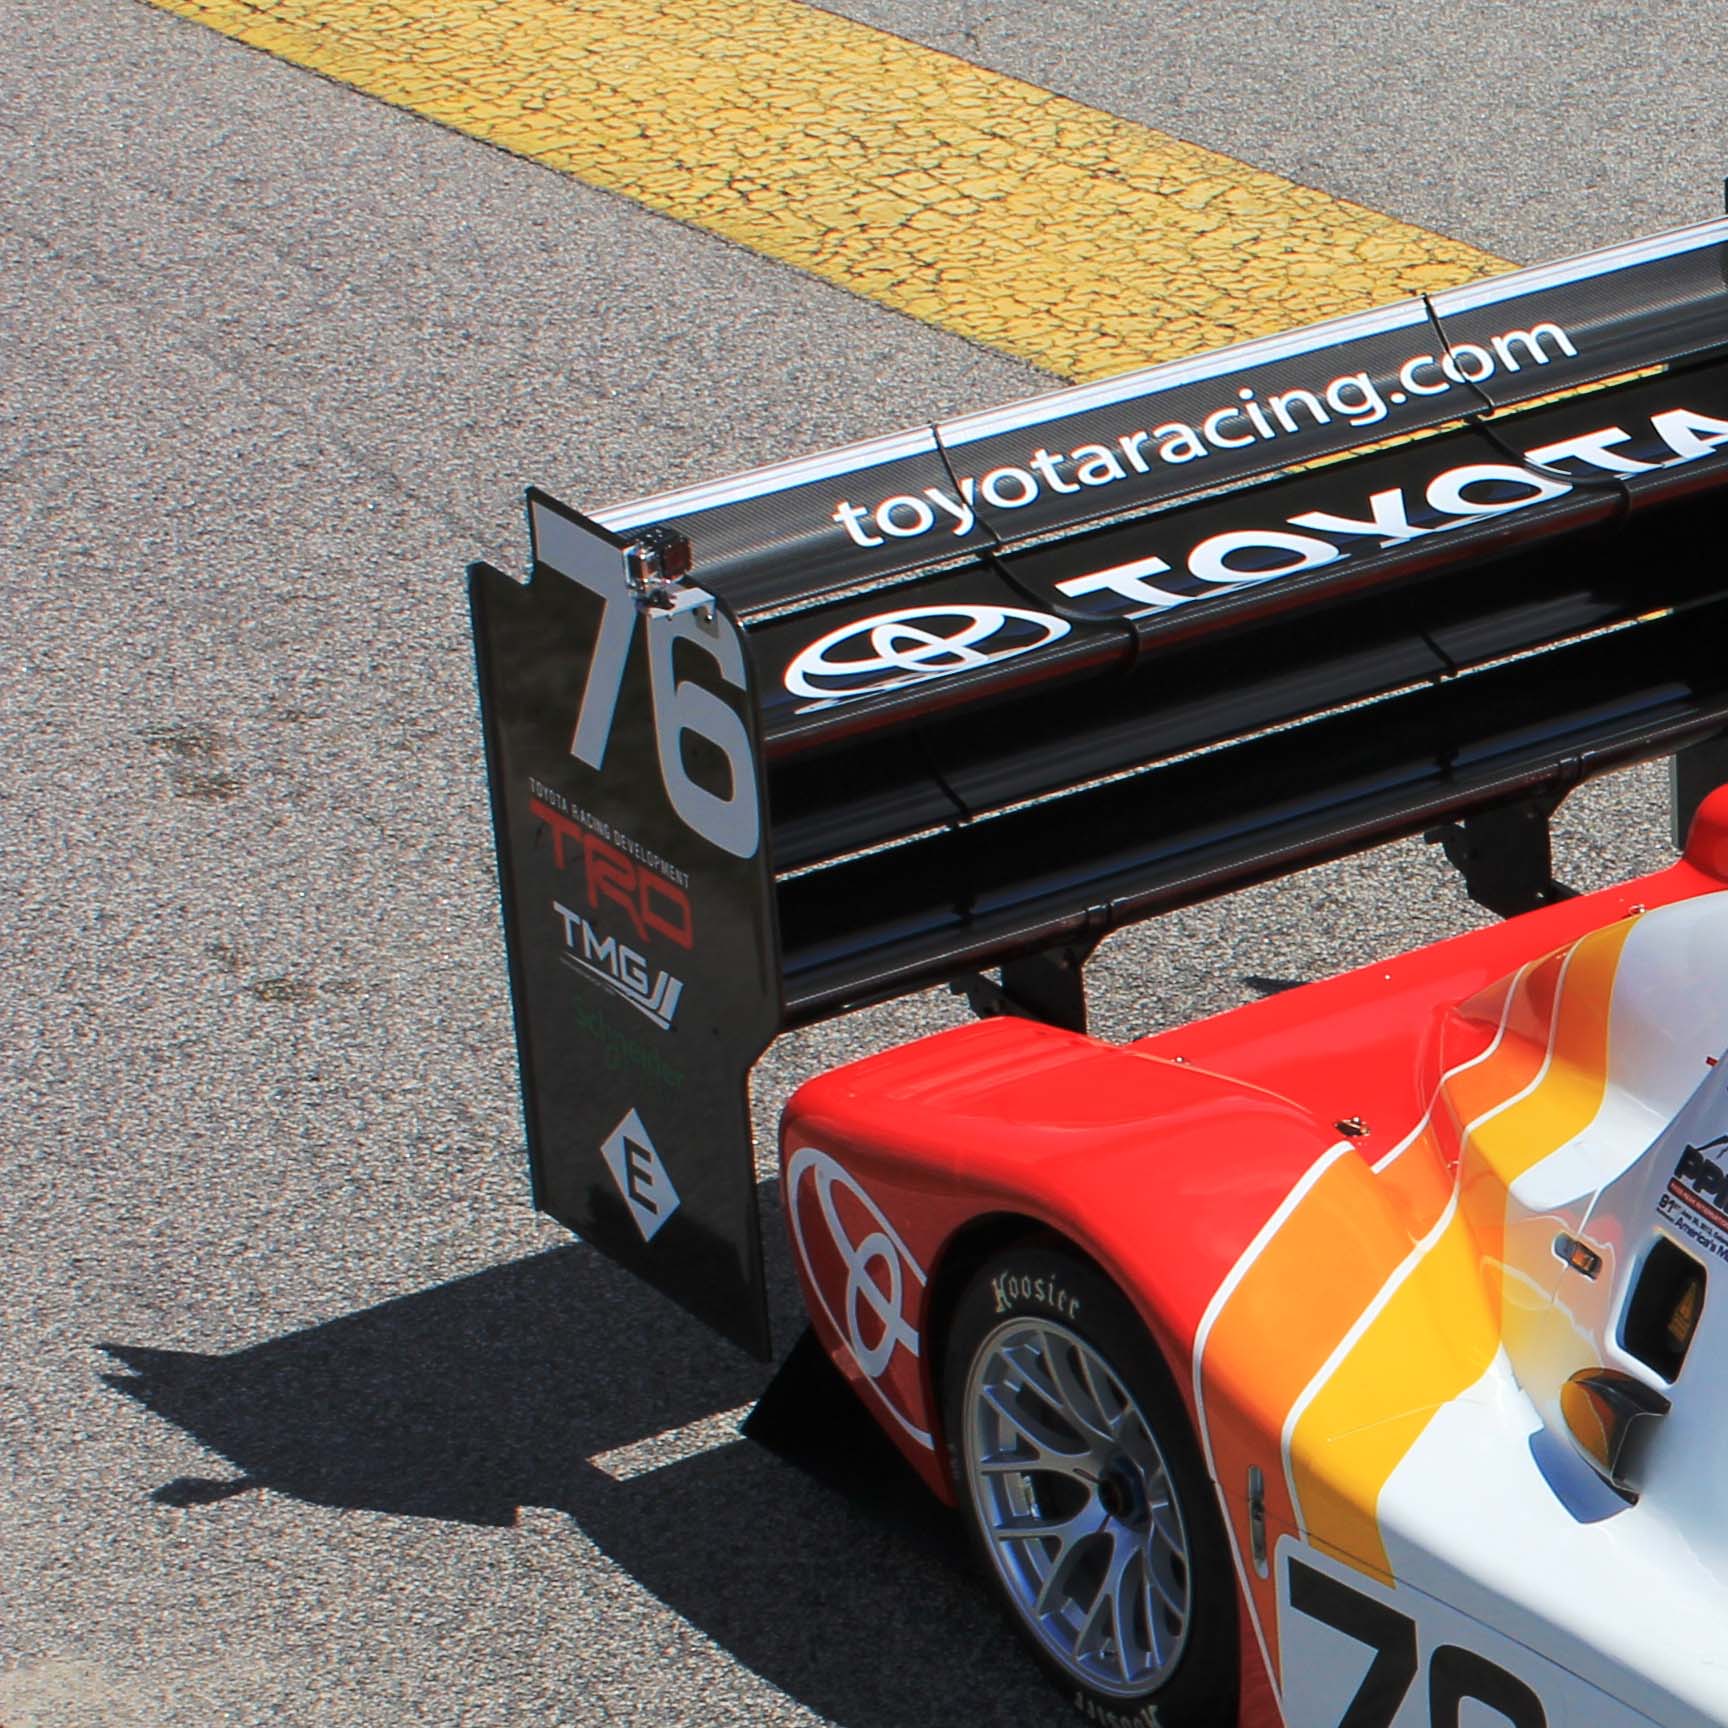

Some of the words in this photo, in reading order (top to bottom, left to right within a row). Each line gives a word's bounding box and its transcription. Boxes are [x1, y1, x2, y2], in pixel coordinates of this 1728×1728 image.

[832, 321, 1578, 548] toyotaracing.com
[532, 498, 760, 859] 76
[529, 777, 568, 813] TOYOTA
[571, 804, 611, 840] RACING
[613, 830, 689, 888] DEVELOPMENT
[529, 799, 694, 951] TRD
[553, 901, 650, 995] TMG
[622, 1136, 658, 1216] E
[1672, 1216, 1720, 1252] America's
[991, 1270, 1081, 1319] Hoosier
